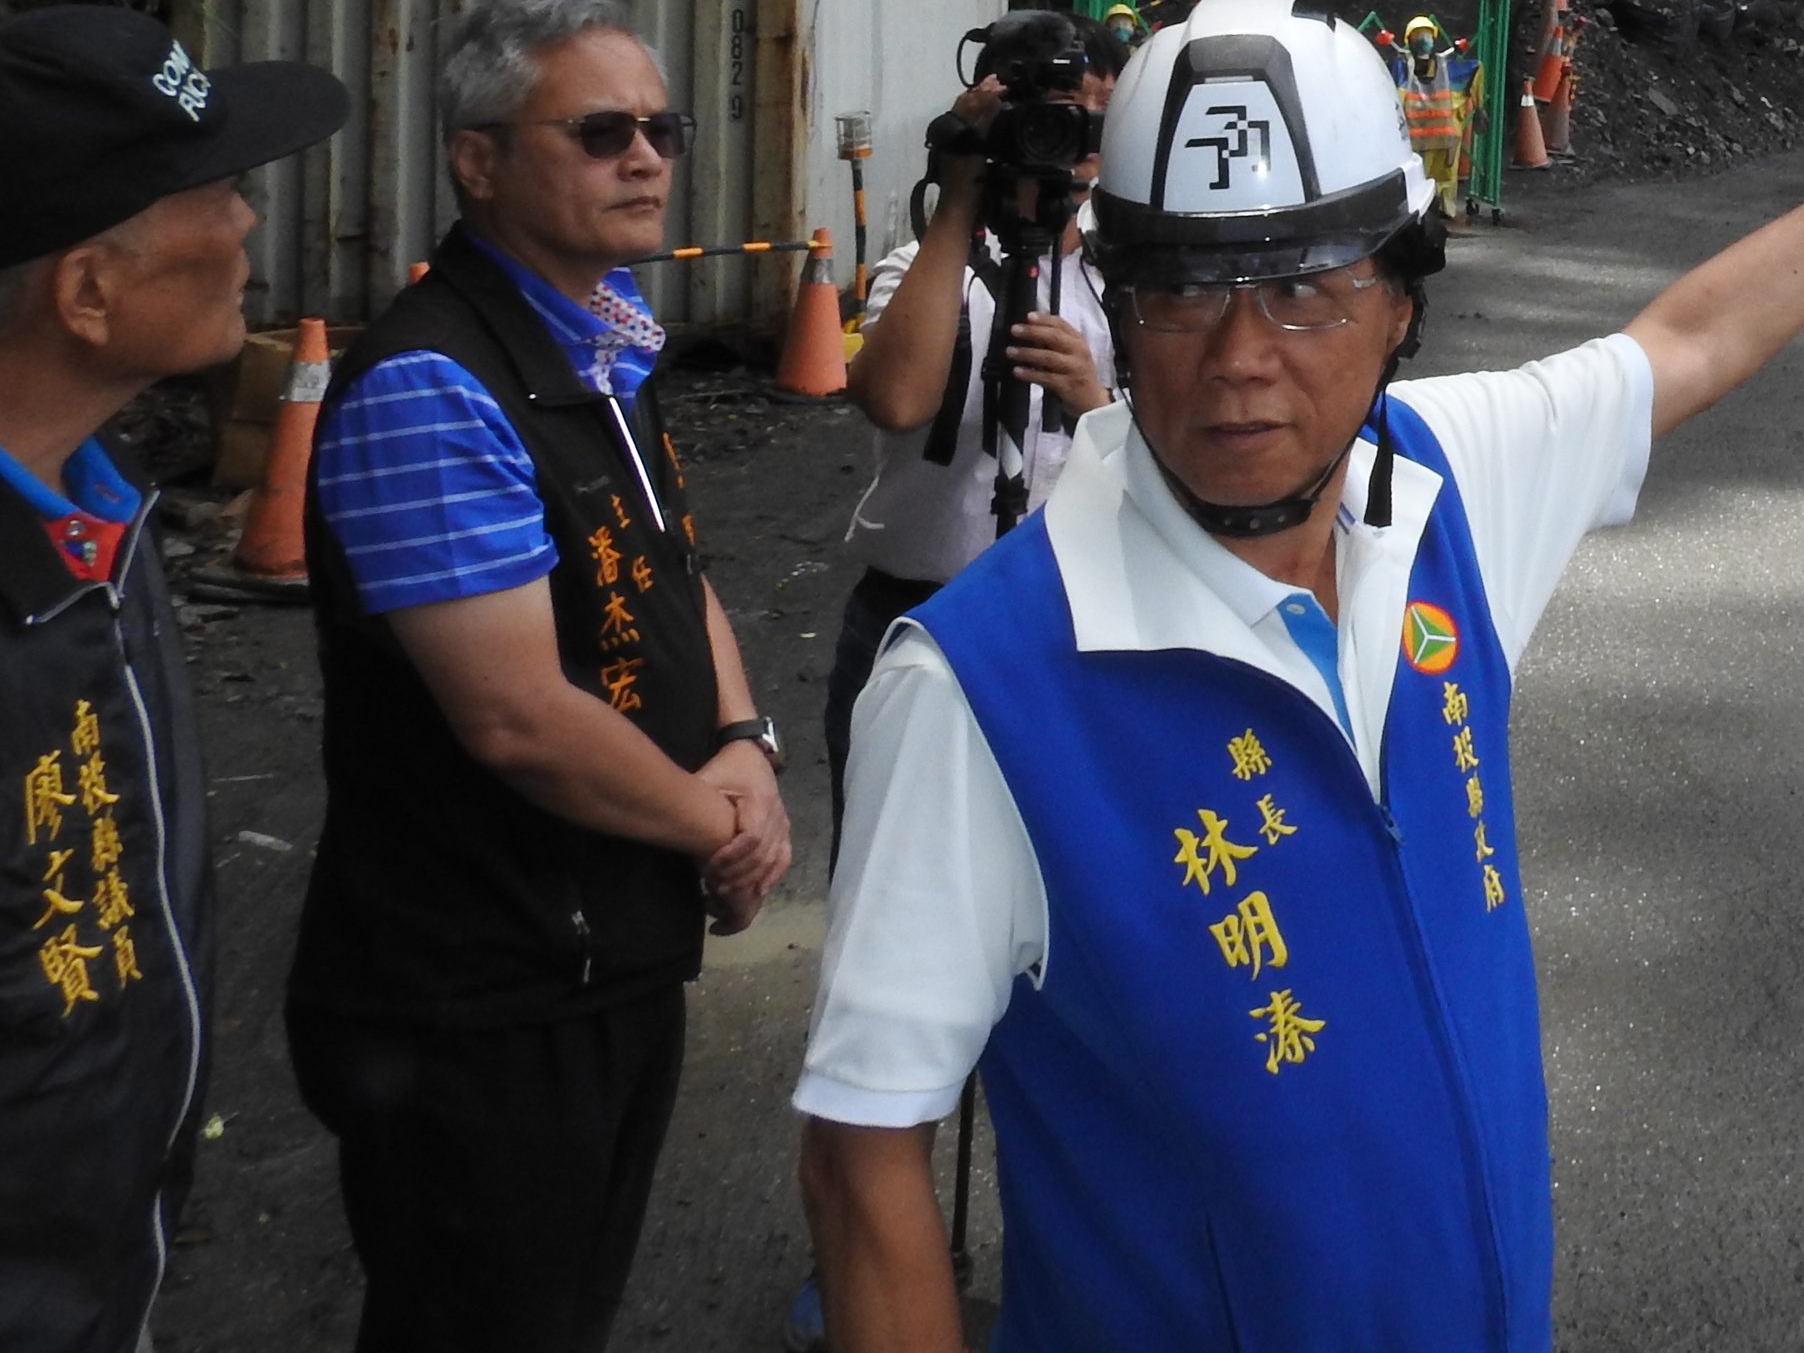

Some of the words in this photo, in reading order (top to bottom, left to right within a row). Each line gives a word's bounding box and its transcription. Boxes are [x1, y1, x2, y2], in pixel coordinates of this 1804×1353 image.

[1226, 726, 1298, 847] 縣長
[1443, 681, 1505, 913] 南投縣政府
[1173, 807, 1327, 1076] 林明溱
